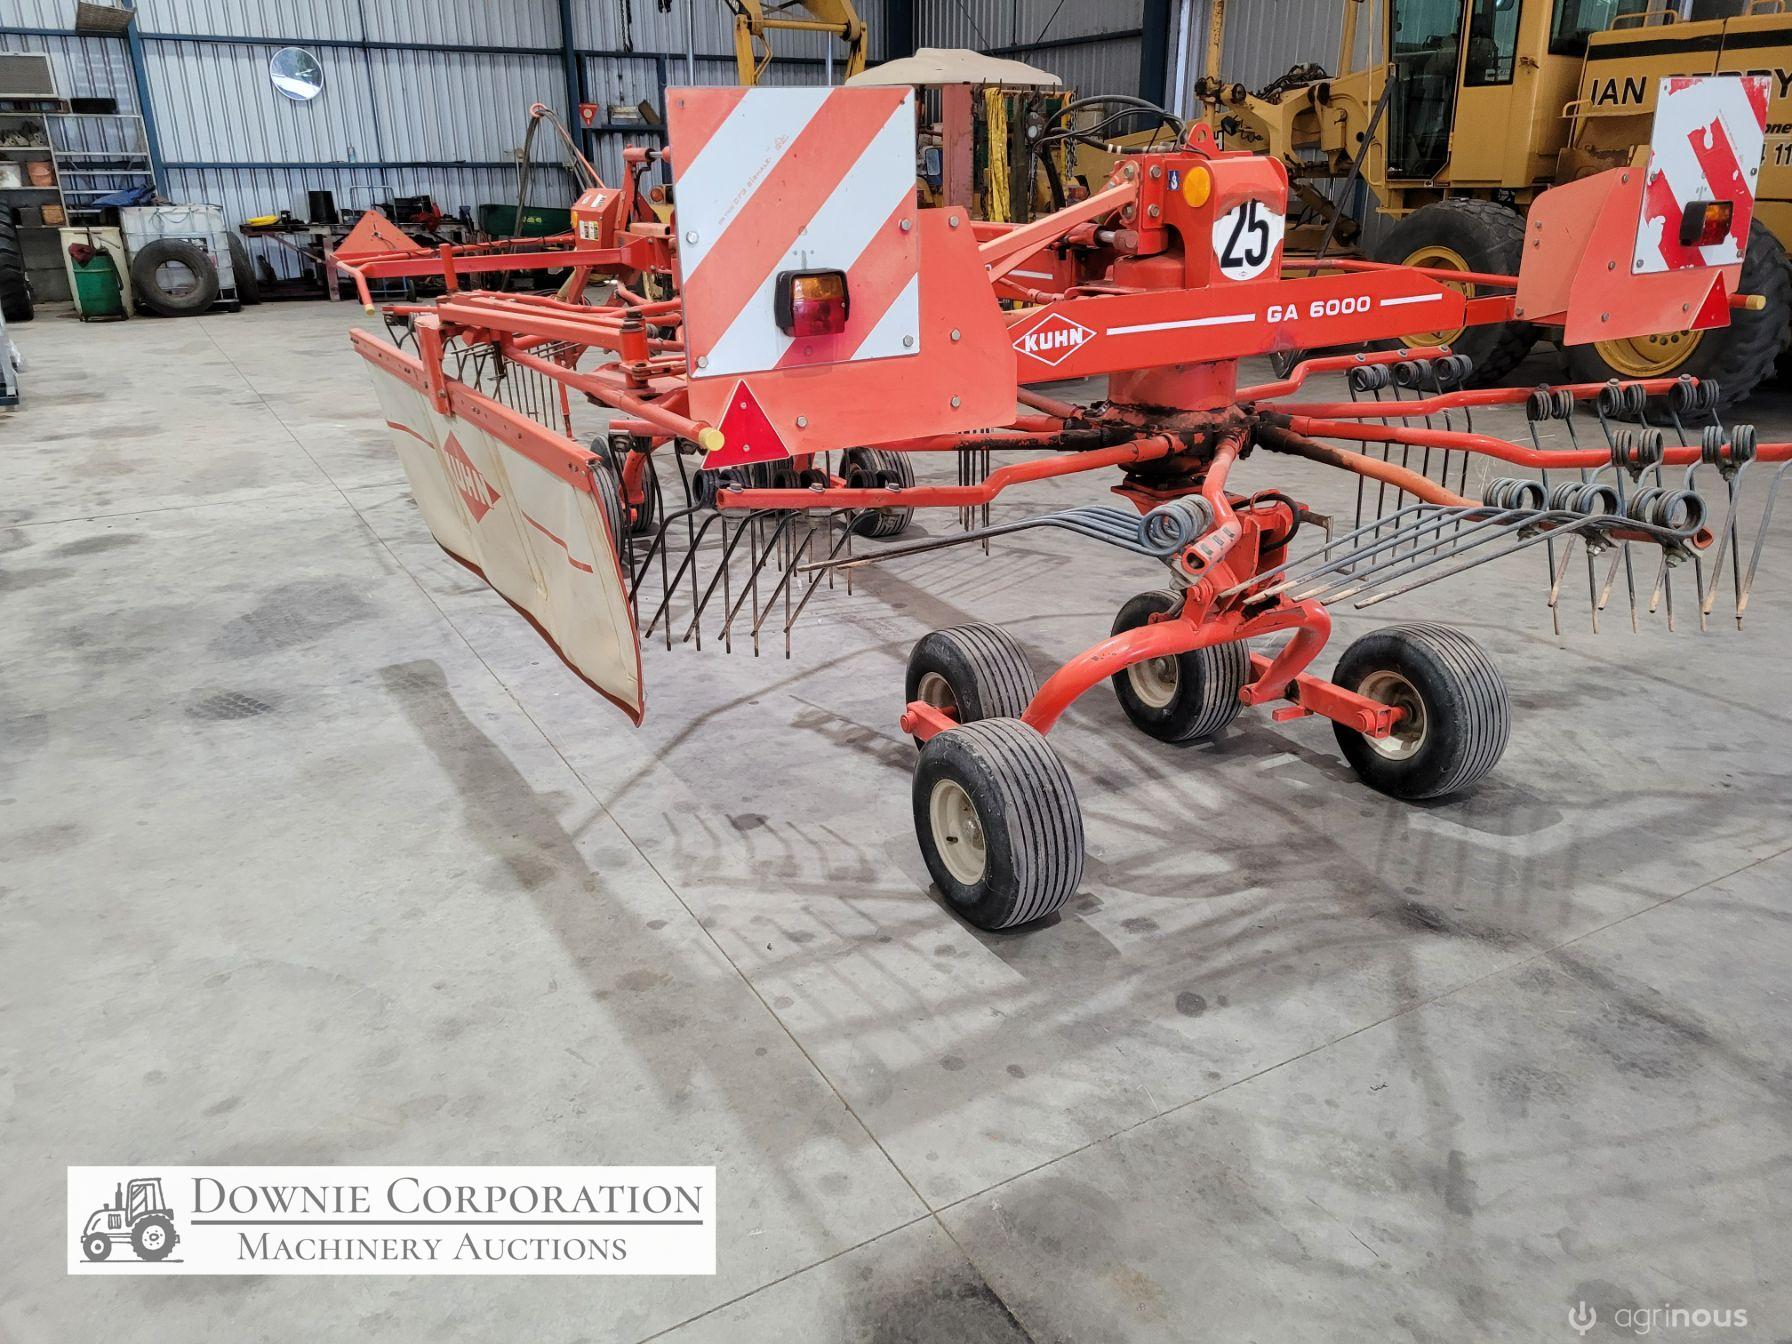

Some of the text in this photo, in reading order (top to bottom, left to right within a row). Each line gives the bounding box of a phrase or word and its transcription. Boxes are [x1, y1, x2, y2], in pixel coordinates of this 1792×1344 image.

[1590, 76, 1648, 106] IAN
[1220, 198, 1270, 269] 25
[1267, 295, 1372, 324] GA 6000
[1024, 327, 1083, 353] KUHN
